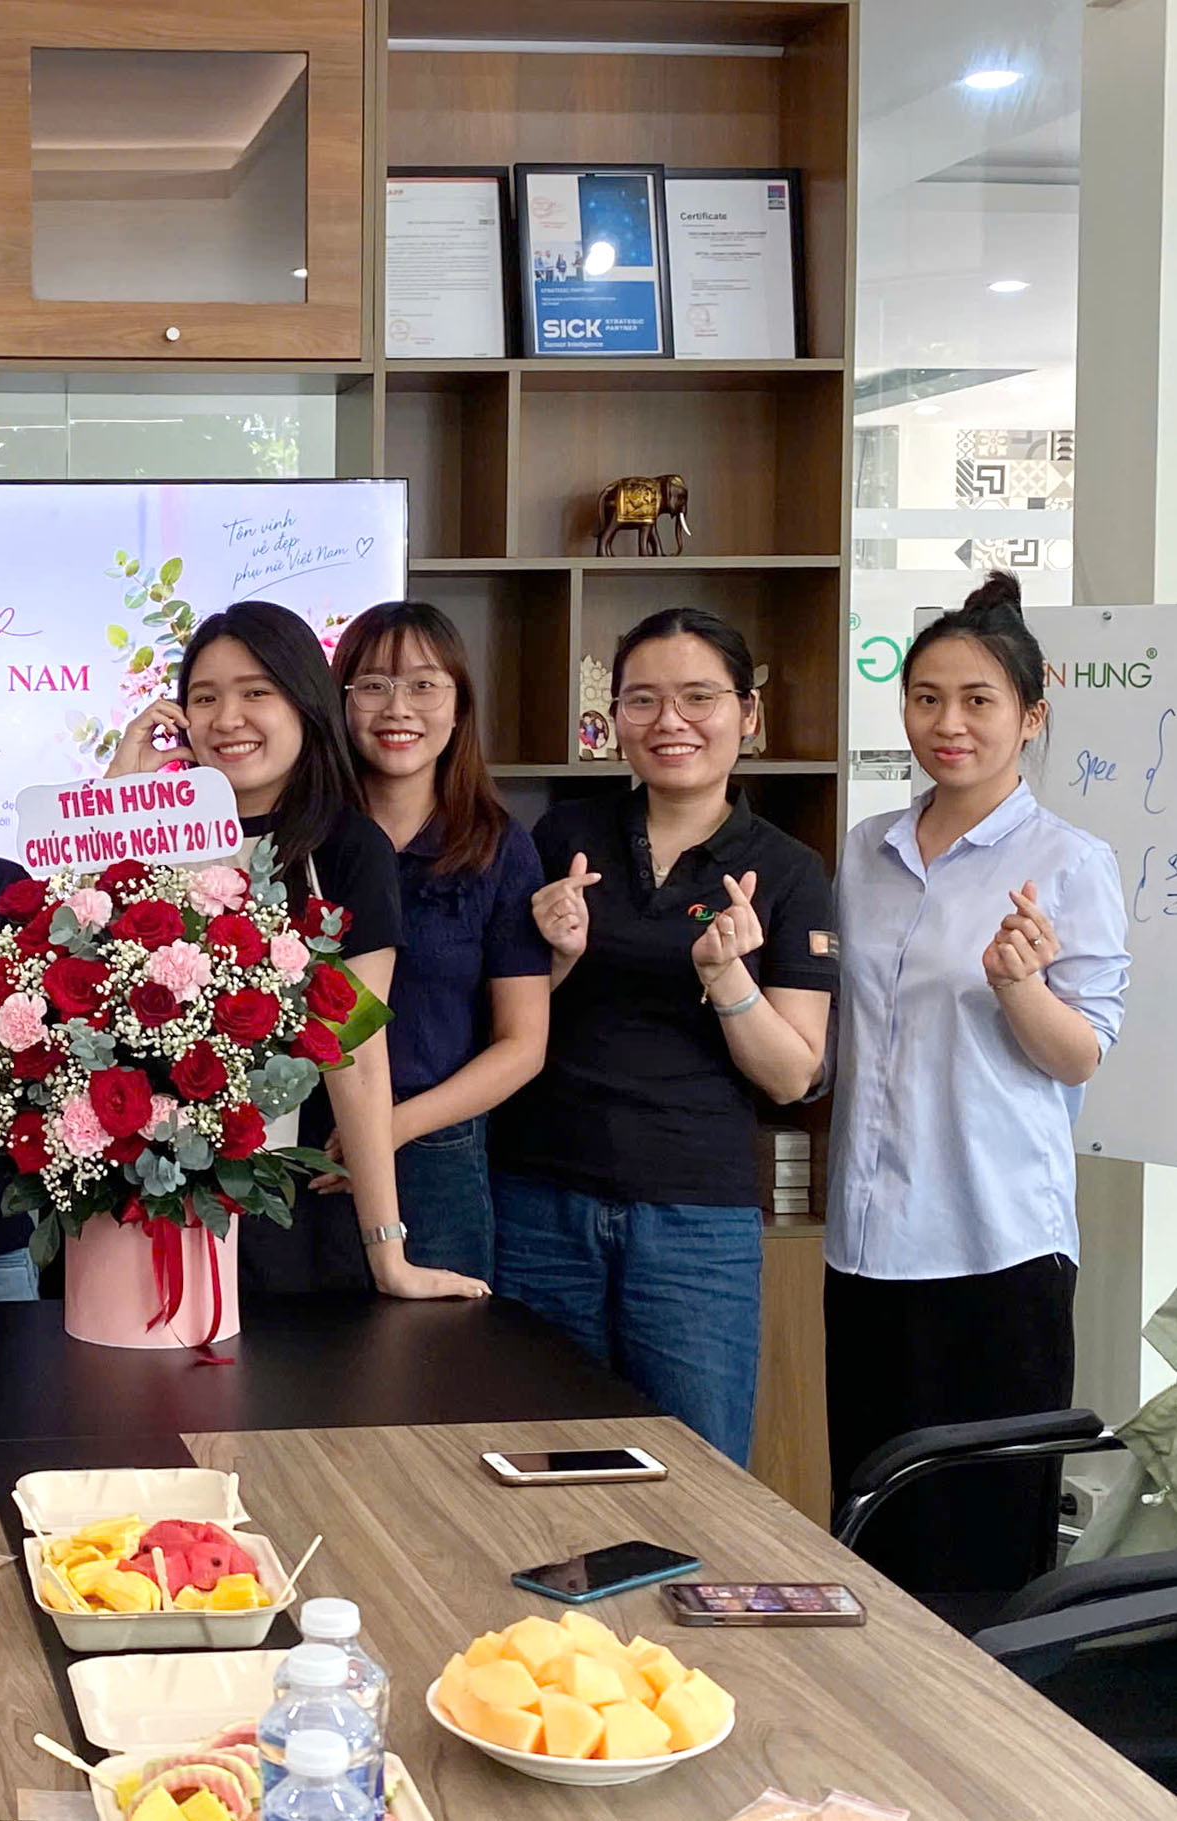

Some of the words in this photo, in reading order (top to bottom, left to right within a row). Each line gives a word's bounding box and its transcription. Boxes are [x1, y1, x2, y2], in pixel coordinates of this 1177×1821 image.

[680, 212, 727, 221] Certificate
[542, 318, 603, 338] SICK
[222, 518, 256, 547] Tôn
[261, 509, 297, 533] vinh
[274, 532, 300, 557] đẹp
[233, 562, 262, 591] phụ
[289, 549, 313, 570] Việt
[317, 546, 349, 560] Nam
[8, 665, 90, 691] NAM
[2, 800, 16, 811] đẹ
[58, 779, 115, 819] TIẾN
[120, 780, 196, 813] HƯNG
[26, 831, 72, 868] CHÚC
[75, 826, 126, 863] MỪNG
[129, 820, 178, 858] NGÀY
[183, 819, 238, 852] 20/10
